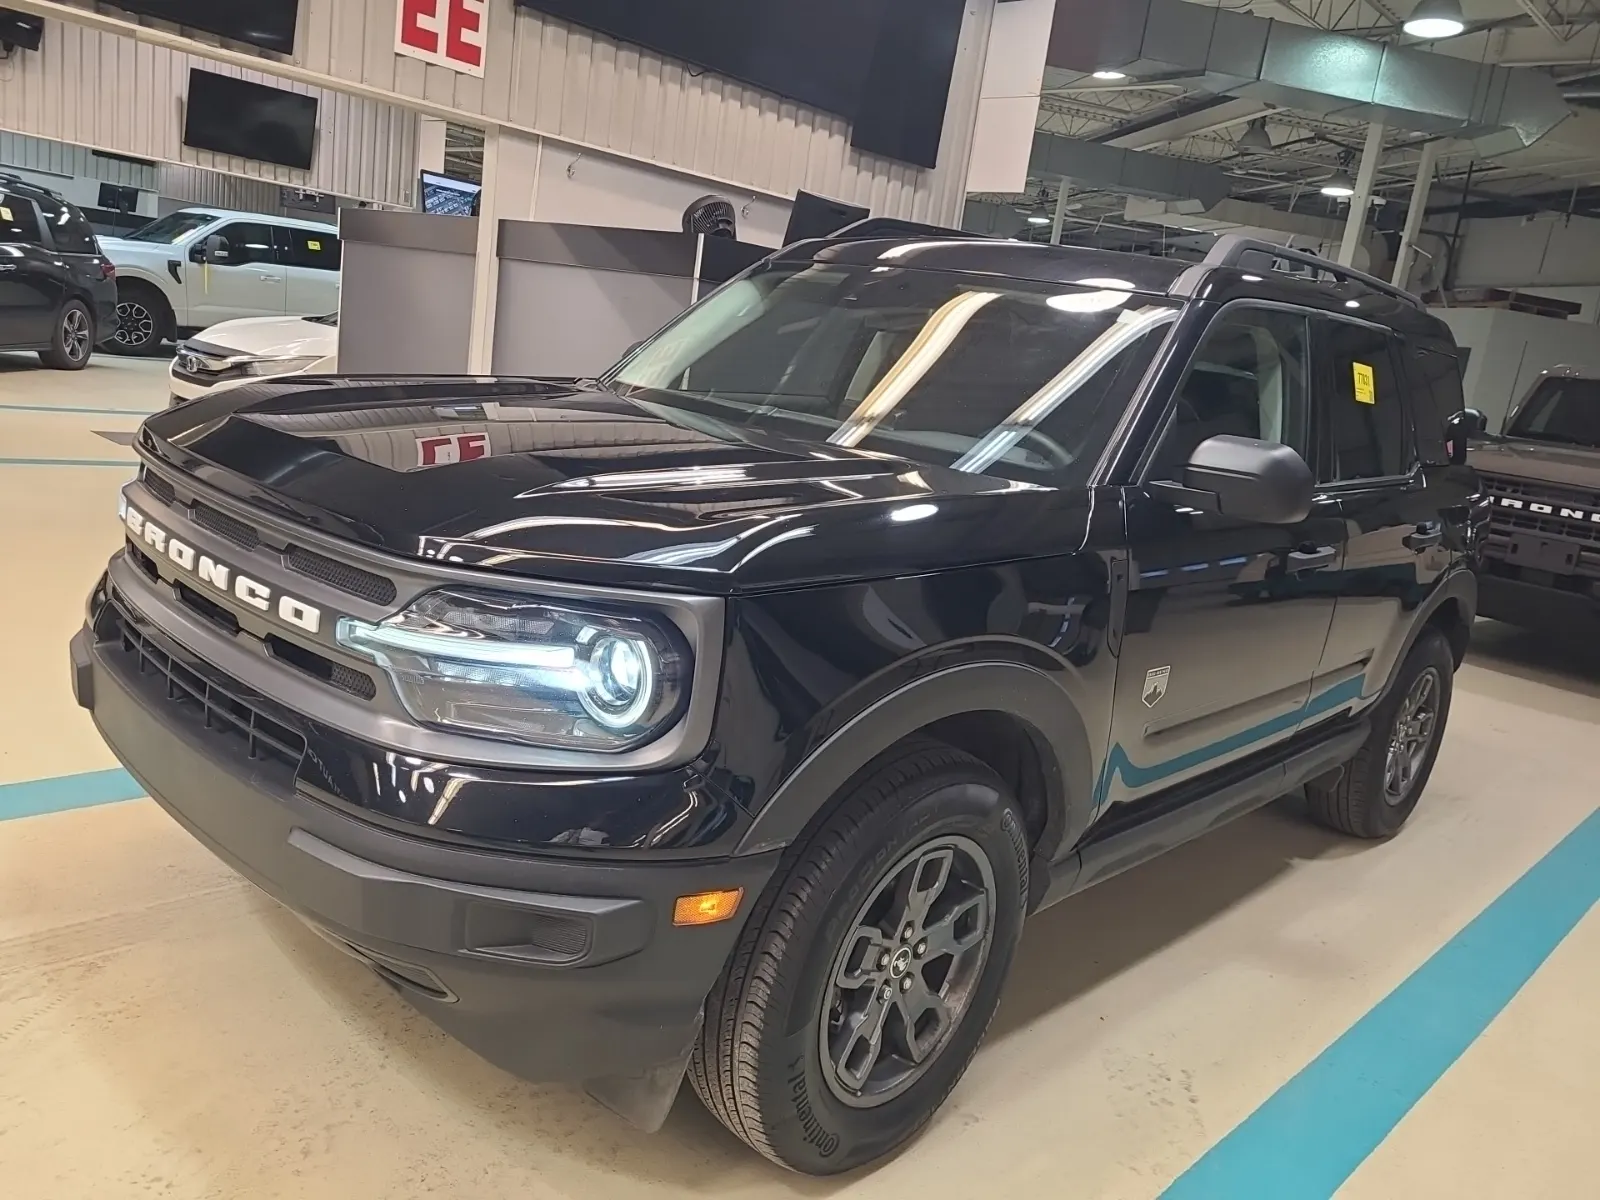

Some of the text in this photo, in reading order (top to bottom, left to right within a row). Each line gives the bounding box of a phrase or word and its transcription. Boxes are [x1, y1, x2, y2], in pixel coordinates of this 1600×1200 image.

[1489, 496, 1600, 522] RON
[126, 506, 320, 633] BRONCO
[787, 1070, 840, 1157] Continental
